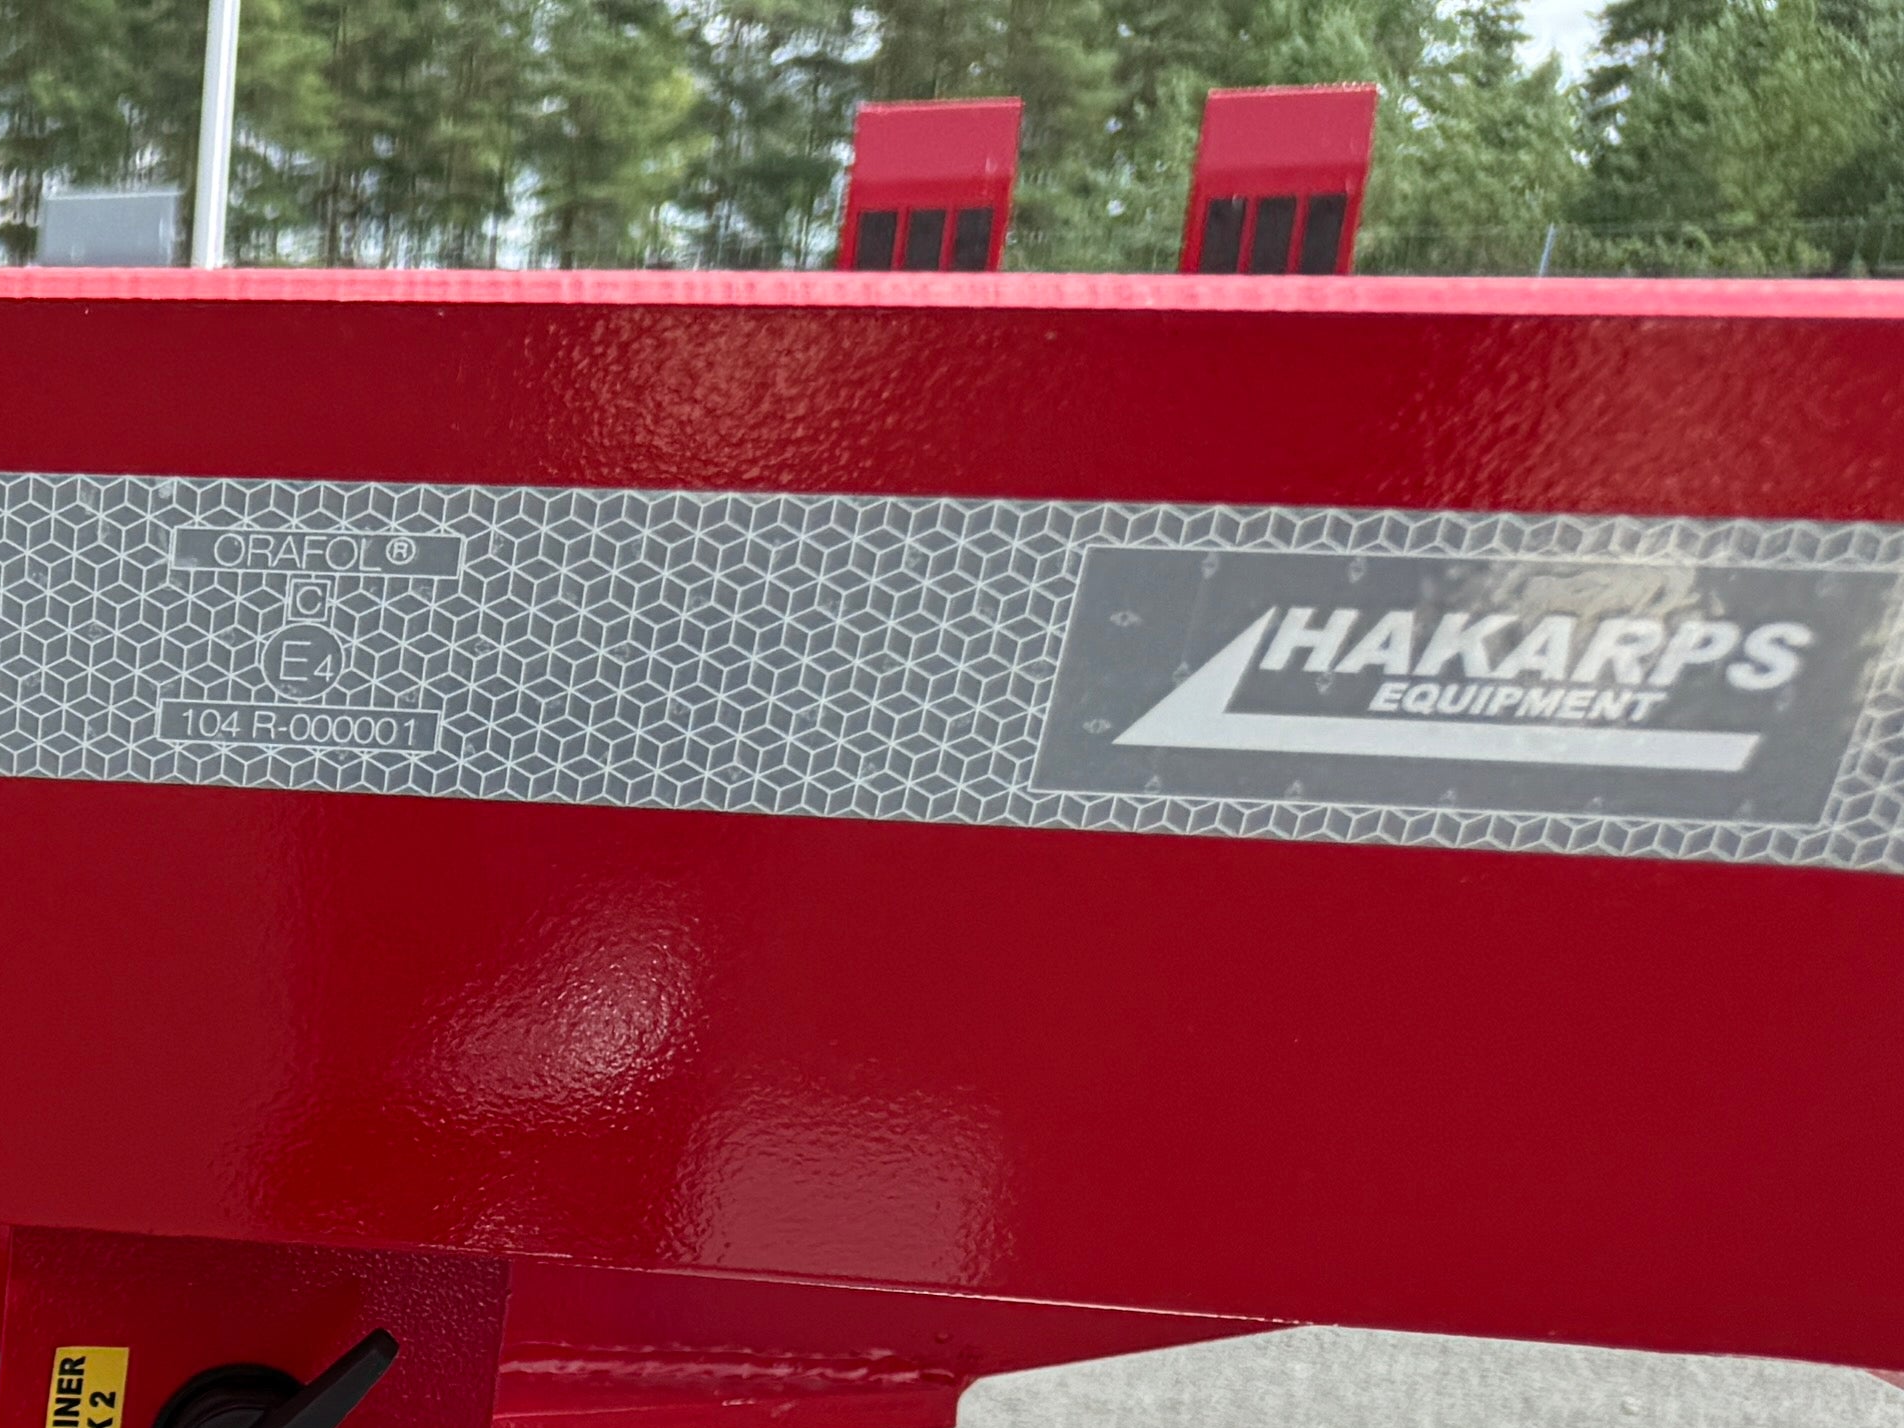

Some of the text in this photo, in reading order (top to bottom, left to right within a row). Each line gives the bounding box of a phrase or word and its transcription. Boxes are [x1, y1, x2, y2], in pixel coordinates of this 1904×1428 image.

[296, 586, 322, 615] C
[1259, 605, 1814, 691] HAKARPS
[1368, 681, 1666, 722] EQUIPMENT
[182, 709, 416, 746] 104 R-000001
[94, 1390, 117, 1410] 2
